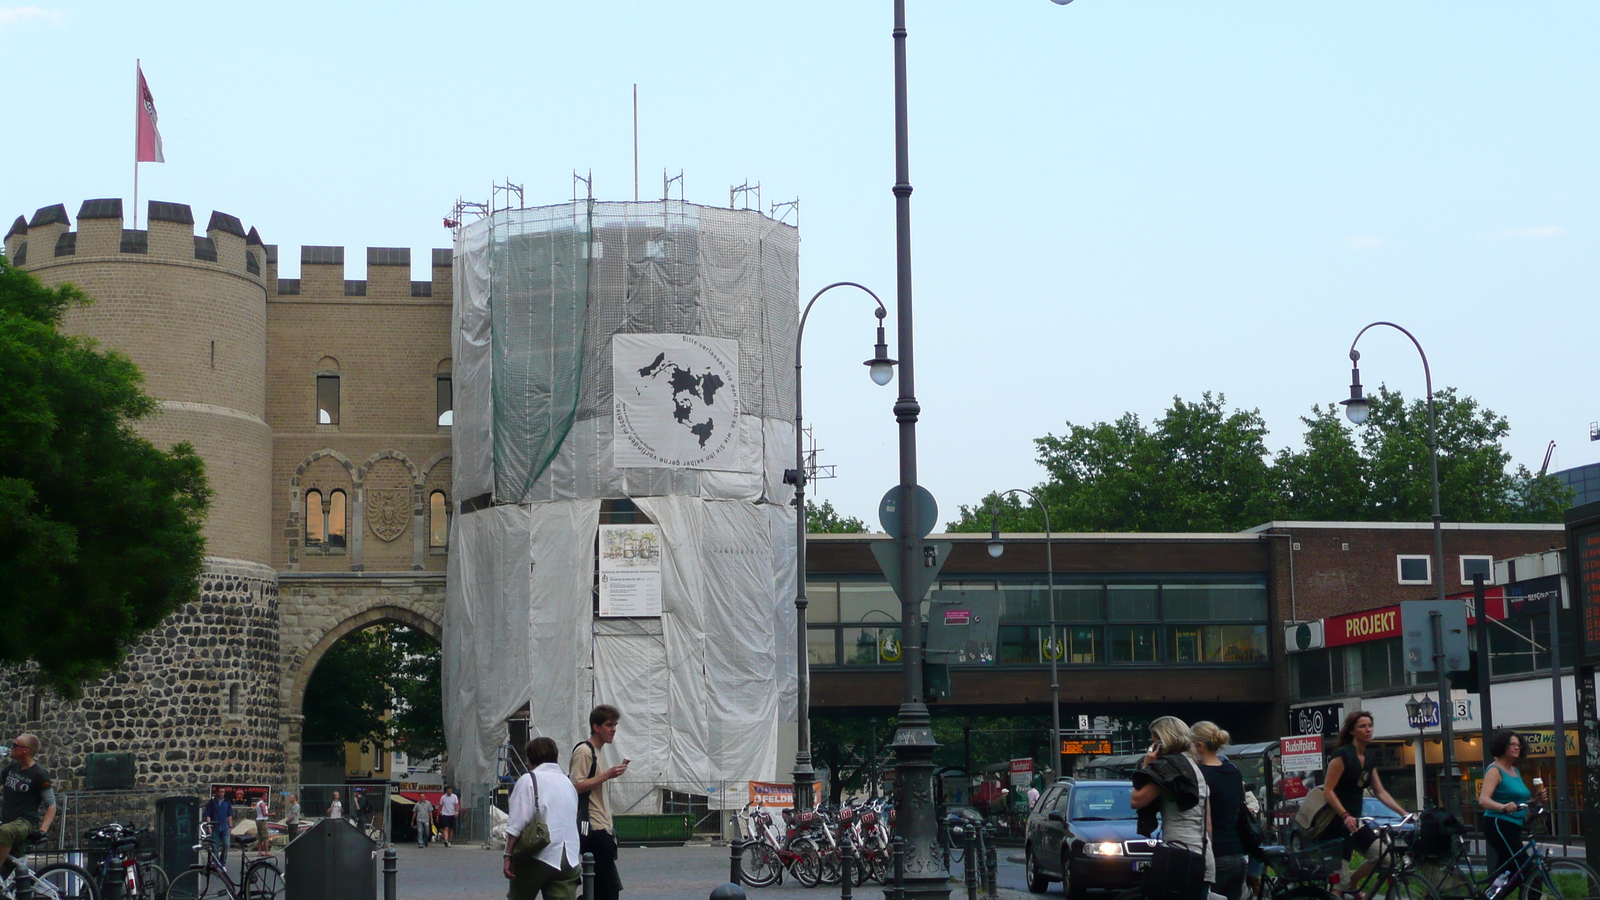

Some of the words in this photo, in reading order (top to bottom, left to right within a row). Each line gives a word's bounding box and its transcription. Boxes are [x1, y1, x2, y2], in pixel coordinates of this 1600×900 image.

[682, 335, 698, 346] Bitte
[699, 343, 726, 370] verlassen
[725, 370, 733, 382] Sie
[723, 432, 733, 444] wie
[627, 435, 657, 460] vorfinden
[715, 443, 726, 453] Sie
[705, 452, 716, 460] ihn
[659, 457, 681, 466] gerne
[683, 458, 704, 466] selber
[1345, 610, 1396, 638] PROJEKT
[1458, 704, 1466, 717] 3
[1081, 718, 1087, 727] 3
[1285, 738, 1317, 754] Rudolfplatz
[753, 785, 794, 794] ODEND
[762, 795, 794, 803] FELDB
[802, 813, 812, 821] DB
[841, 810, 851, 819] DB
[863, 813, 874, 822] DB
